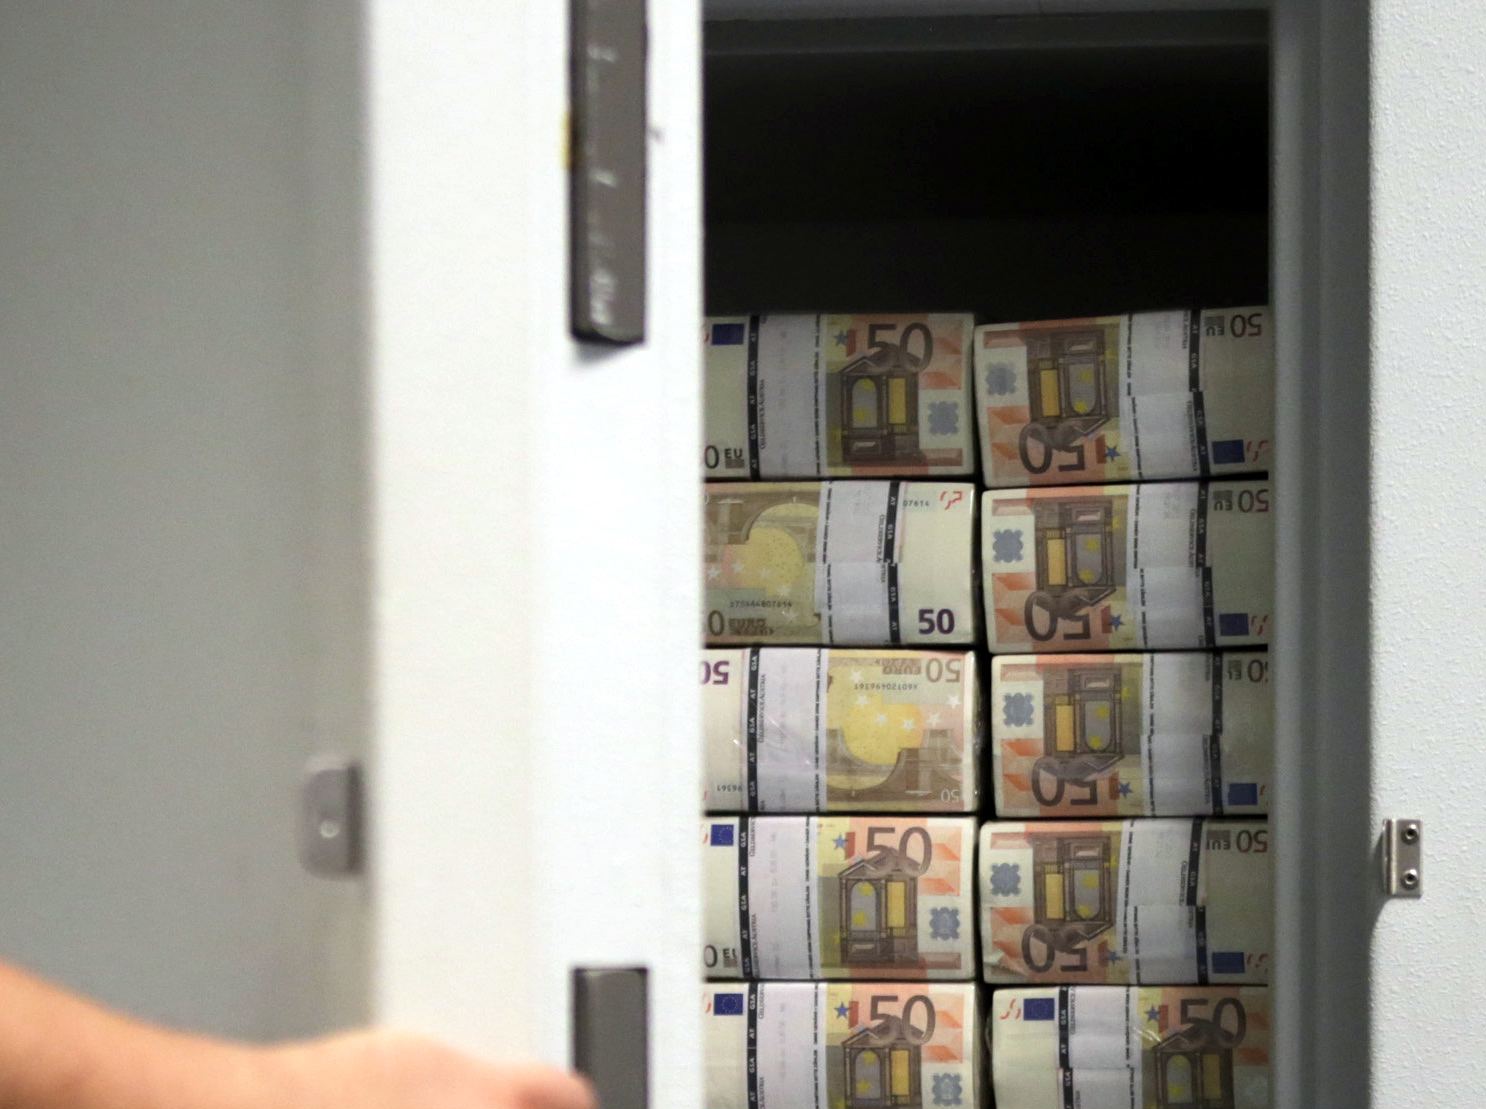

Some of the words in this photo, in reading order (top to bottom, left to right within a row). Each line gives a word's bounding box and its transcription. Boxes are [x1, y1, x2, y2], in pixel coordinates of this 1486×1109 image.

[1230, 313, 1262, 338] 50
[868, 322, 933, 372] 50
[705, 445, 719, 469] 0
[1019, 421, 1085, 474] 50
[1238, 489, 1269, 513] 50
[708, 610, 724, 636] 0
[918, 609, 954, 634] 50
[1024, 591, 1091, 641] 50
[925, 658, 961, 683] 50
[1031, 755, 1098, 806] 50
[866, 826, 932, 876] 50
[741, 867, 746, 876] AT
[704, 945, 718, 968] 0
[1021, 923, 1088, 973] 50
[870, 995, 936, 1045] 50
[1180, 998, 1246, 1049] 50
[749, 1029, 754, 1039] AT
